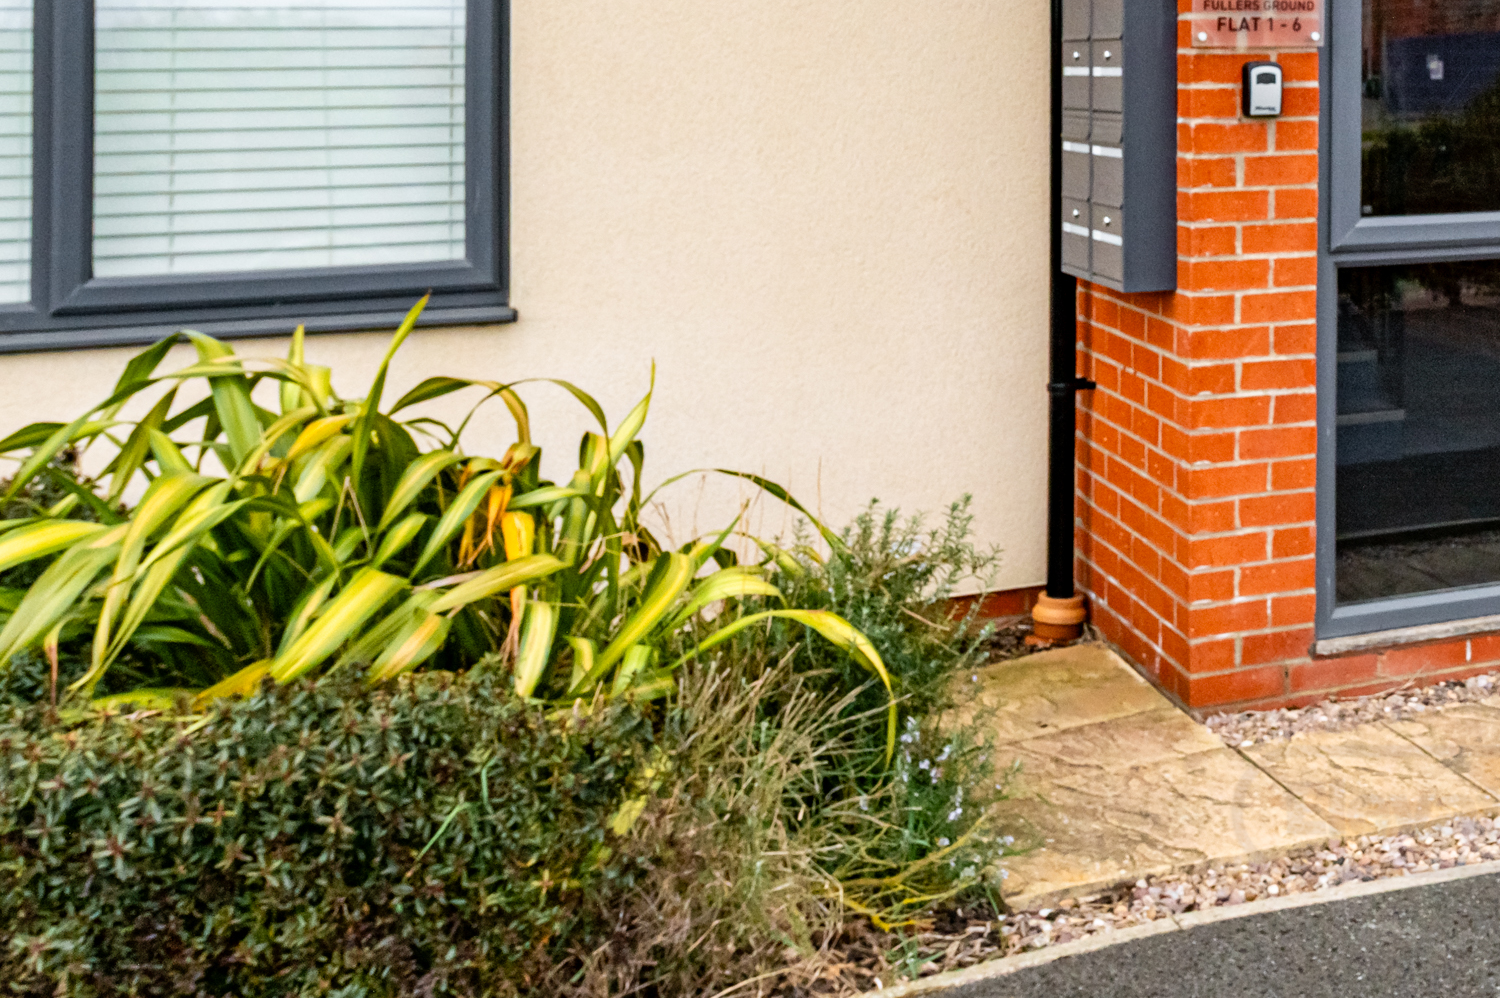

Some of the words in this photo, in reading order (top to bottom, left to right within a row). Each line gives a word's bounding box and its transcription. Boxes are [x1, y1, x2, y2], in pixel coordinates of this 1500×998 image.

[1203, 0, 1260, 11] FULLERS
[1263, 0, 1315, 12] GROUND
[1217, 17, 1261, 32] FLAT
[1268, 17, 1274, 32] 1
[1292, 17, 1302, 32] 6
